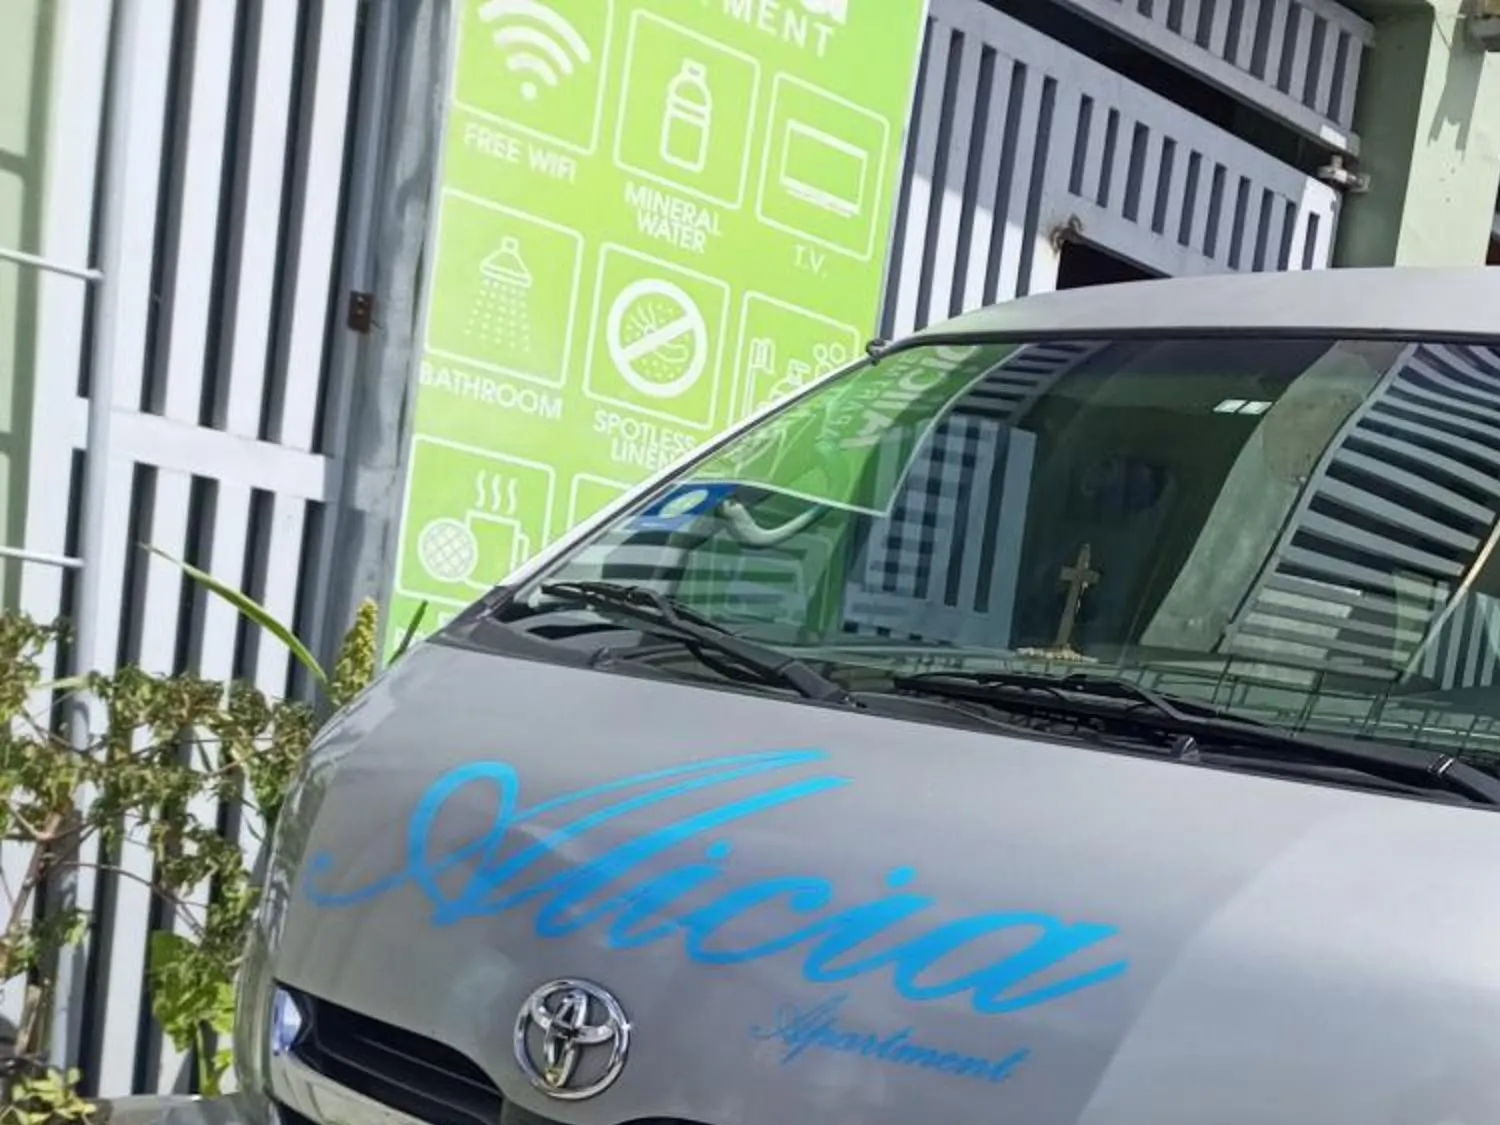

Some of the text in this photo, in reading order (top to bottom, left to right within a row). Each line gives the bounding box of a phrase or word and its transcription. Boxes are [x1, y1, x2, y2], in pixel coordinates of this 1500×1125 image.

[722, 0, 835, 57] MENT
[464, 121, 578, 183] FREE WIFI
[624, 180, 722, 238] MINERAL
[637, 210, 706, 254] WATER
[417, 360, 563, 418] BATHROOM
[592, 408, 698, 455] SPOTLESS
[301, 748, 1131, 1015] Alicia
